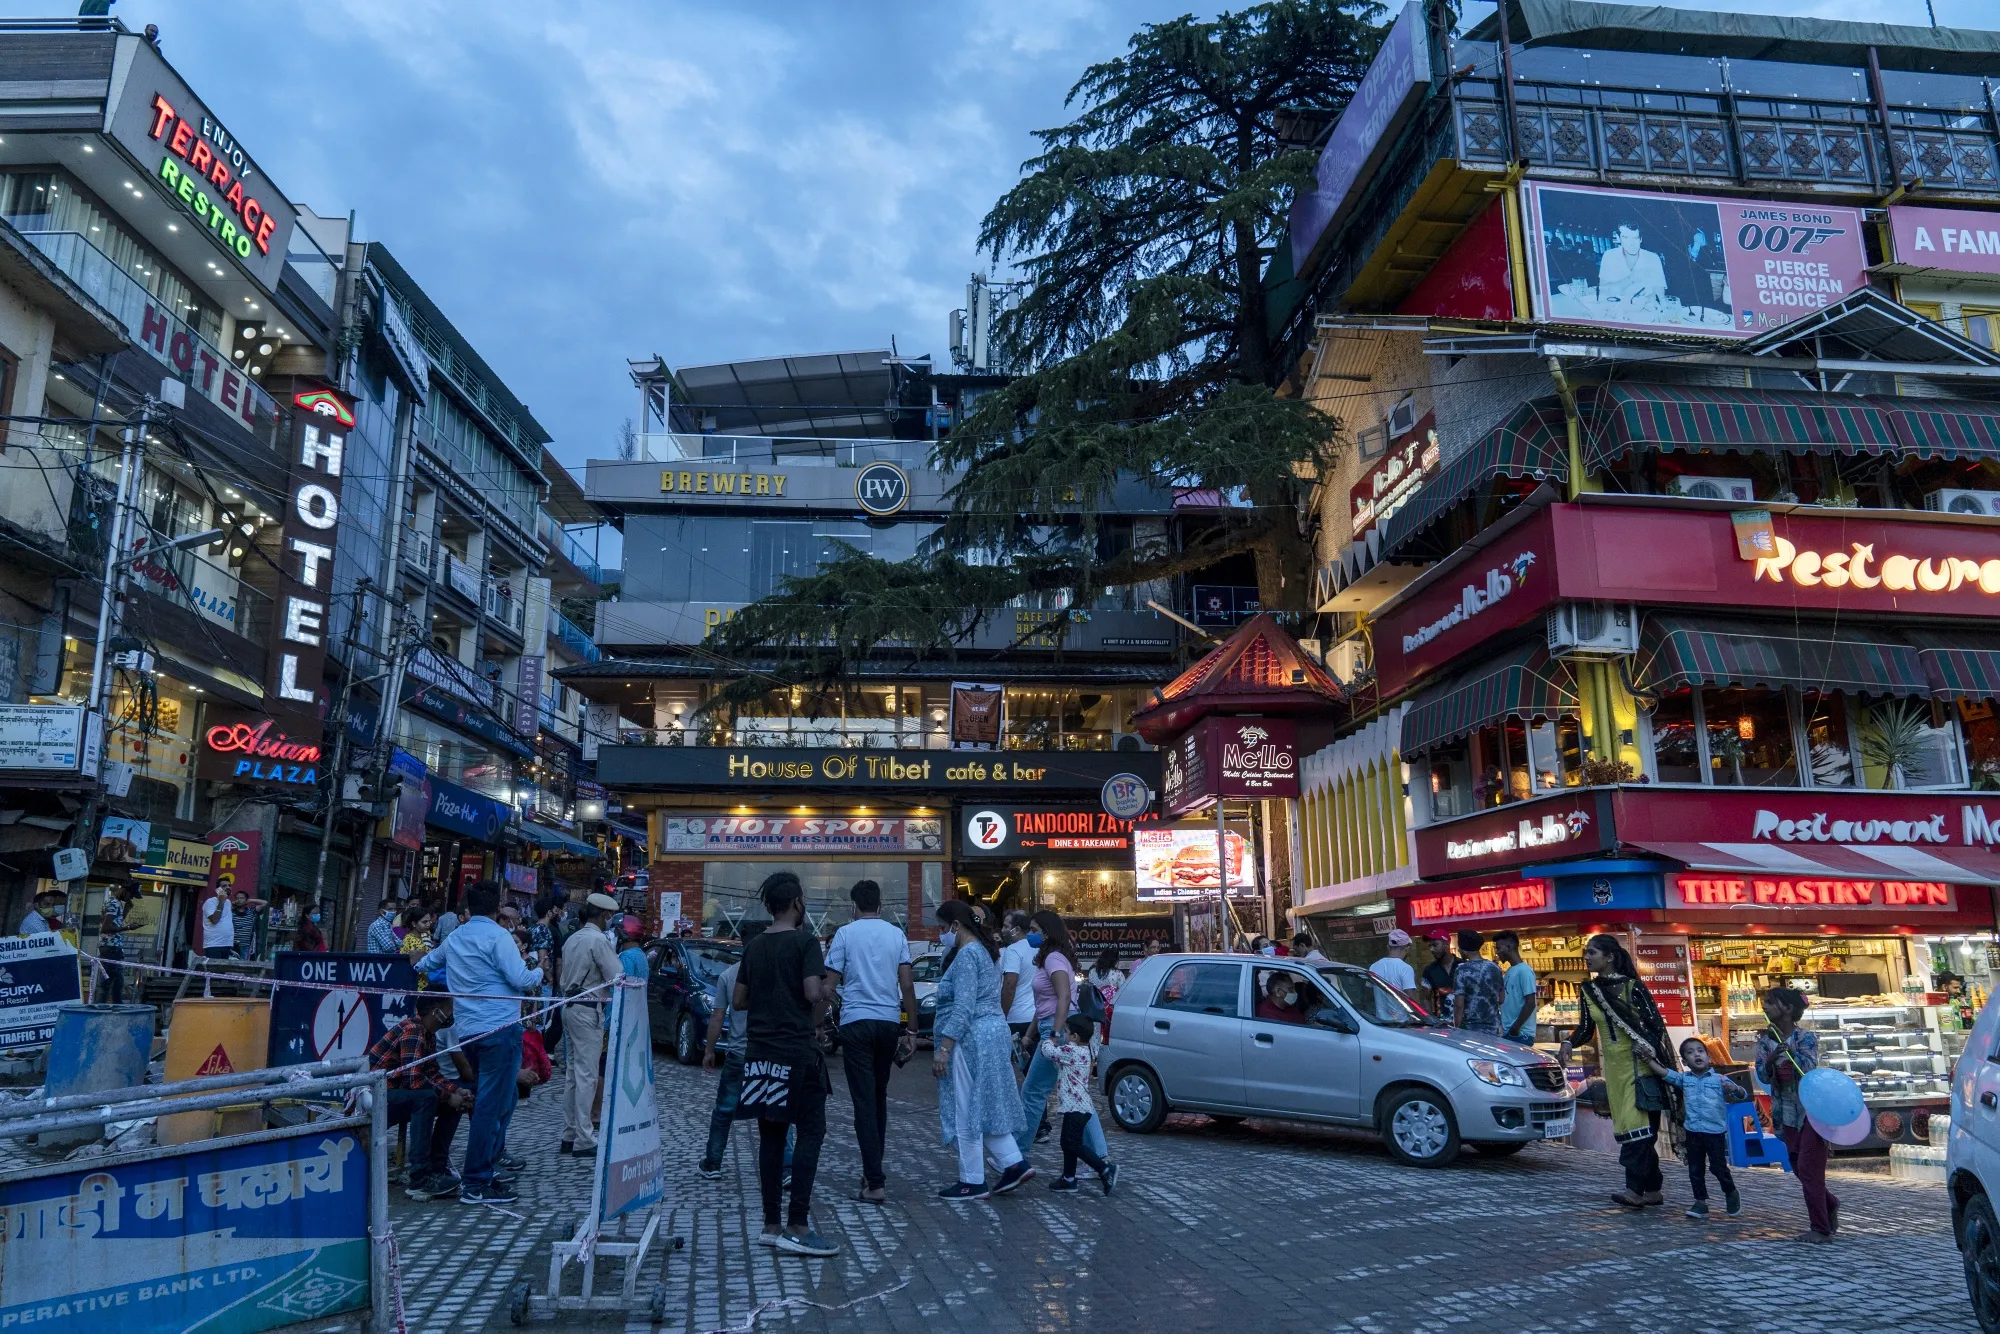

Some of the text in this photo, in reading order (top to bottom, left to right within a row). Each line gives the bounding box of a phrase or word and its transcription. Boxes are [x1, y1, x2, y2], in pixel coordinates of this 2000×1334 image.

[1365, 39, 1397, 108] OPEN
[1358, 55, 1412, 155] TERRACE
[201, 117, 251, 178] ENJOY
[148, 92, 276, 255] TERRACE
[159, 156, 251, 258] RESTRO
[1740, 209, 1833, 224] JAMES BOND
[1738, 223, 1820, 254] 007
[1914, 226, 2000, 255] A FAM
[1764, 260, 1829, 277] PIERCE
[1755, 275, 1842, 294] BROSNAN
[1759, 291, 1828, 307] CHOICE
[141, 303, 256, 426] HOTEL
[660, 471, 787, 496] BREWERY
[278, 423, 345, 704] HOTEL
[191, 586, 236, 622] PLAZA
[1016, 612, 1042, 622] CAFE
[414, 664, 436, 683] CURRY
[520, 658, 536, 733] RESTAURANT
[207, 718, 321, 764] Asian
[235, 760, 317, 786] PLAZA
[729, 754, 1047, 781] House Of Tibet café & bar
[1222, 770, 1294, 779] Multi Cuisine Restaurant
[1112, 782, 1136, 799] BR
[435, 791, 479, 824] Pizza Hut
[711, 819, 900, 835] HOT SPOT
[1013, 812, 1094, 834] TANDOORI
[1752, 809, 1949, 843] Restaurant
[709, 835, 900, 843] A FAMILY RESTAURANT
[1055, 839, 1073, 847] DINE
[1081, 839, 1120, 847] TAKEAWAY
[1154, 888, 1200, 896] Indian Chinese
[1411, 884, 1546, 919] THE PASTRY DEN
[1678, 879, 1747, 904] THE
[1753, 880, 1875, 905] PASTRY
[1373, 918, 1389, 931] RAIN
[0, 937, 55, 952] SHALA CLEAN
[1832, 947, 1849, 955] ASSI
[301, 961, 392, 982] ONE WAY
[0, 984, 44, 998] SURYA
[0, 1030, 36, 1044] TRAFFIC
[201, 1053, 231, 1075] Sika
[2, 1266, 263, 1328] PERATIVE BANK LTD.
